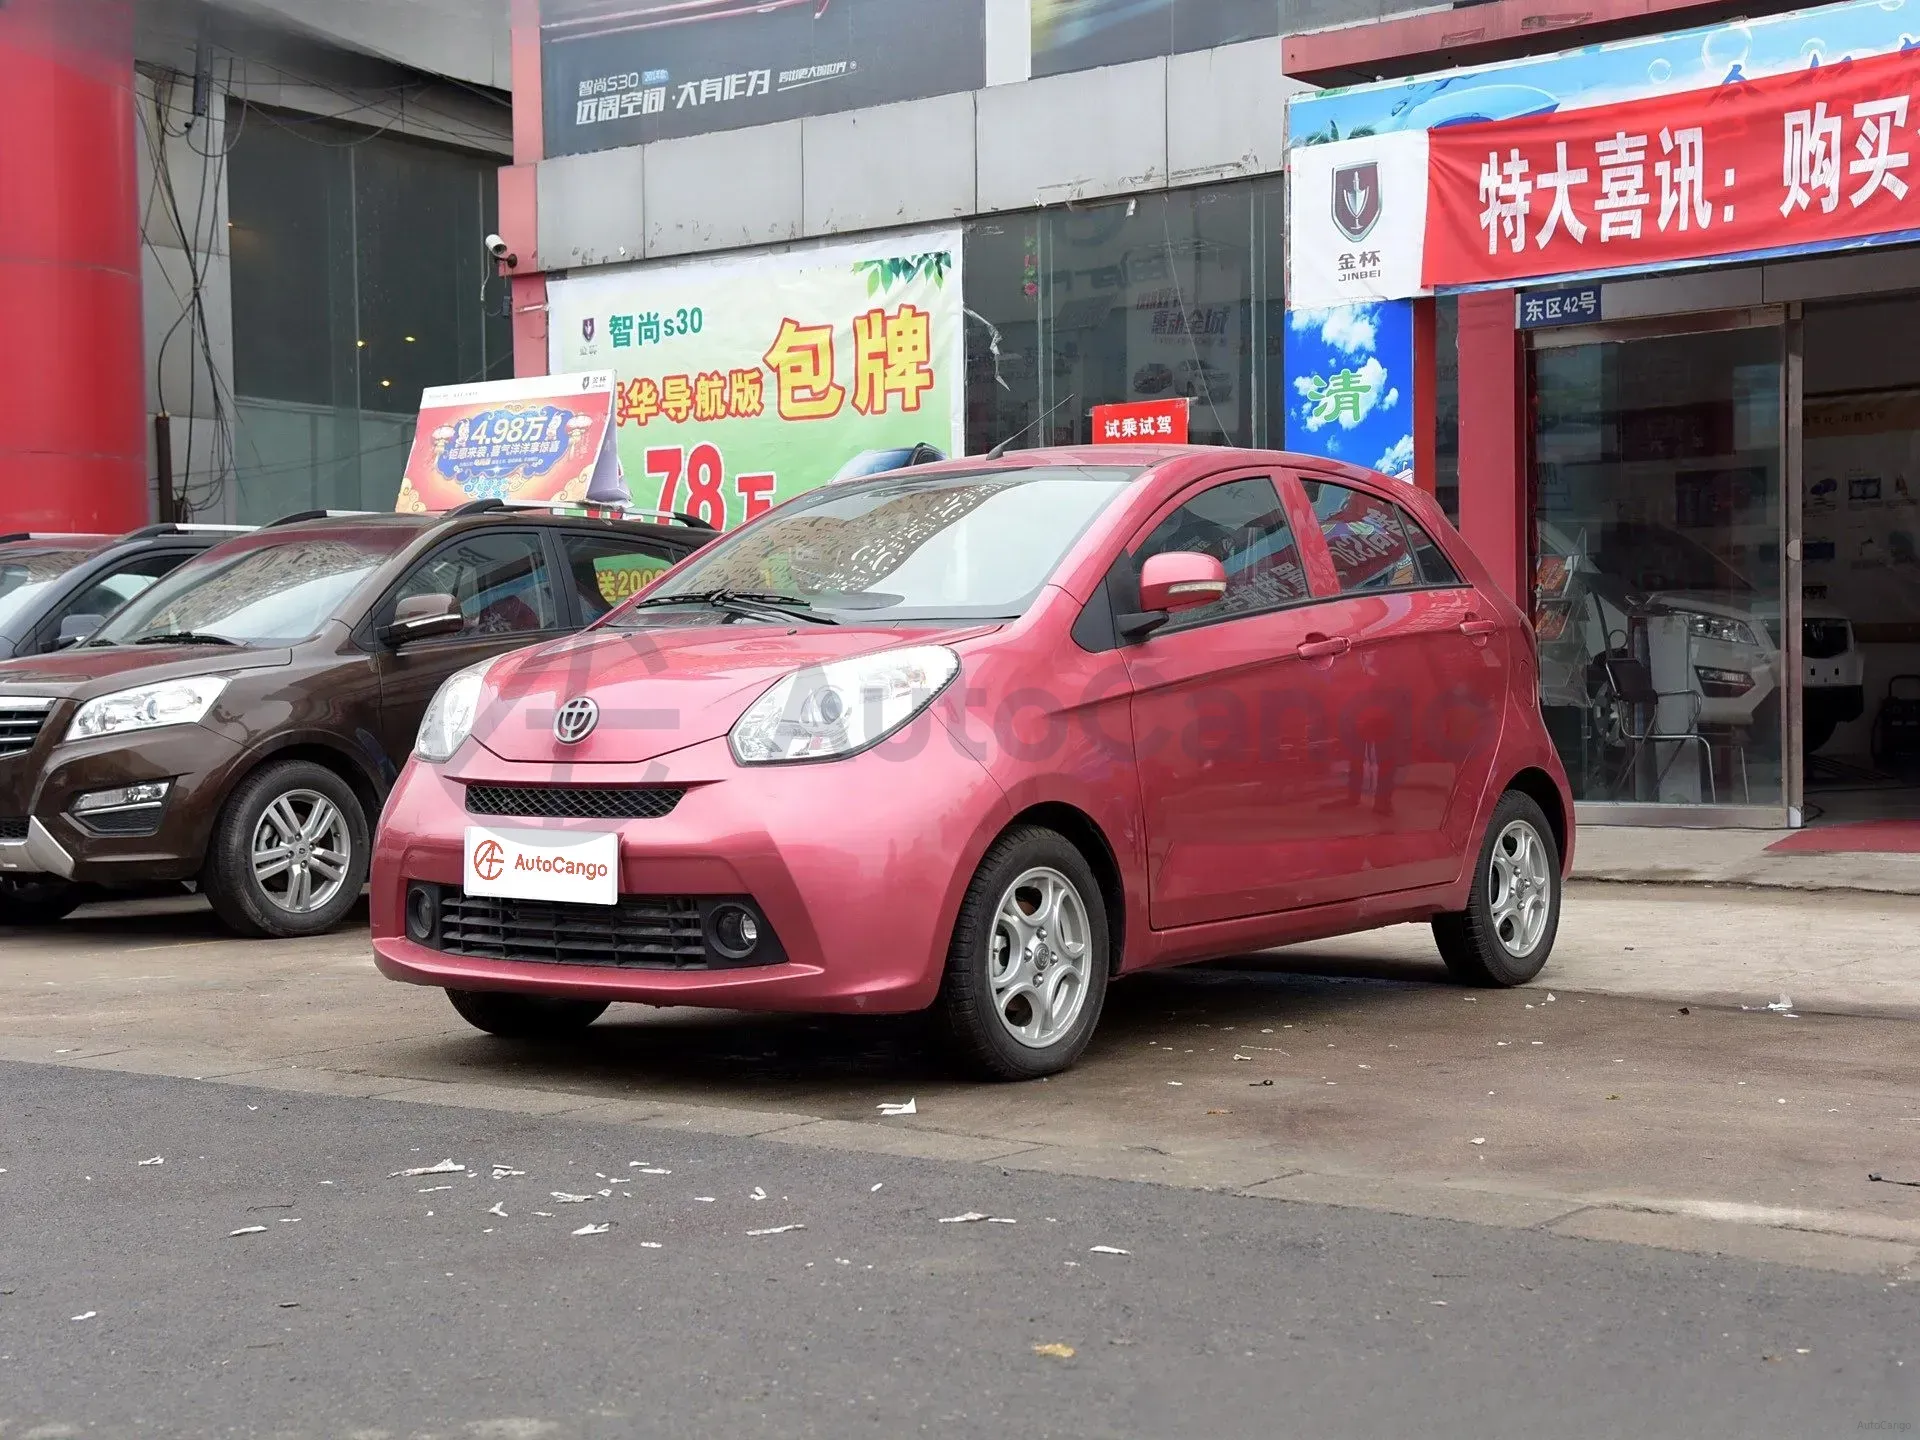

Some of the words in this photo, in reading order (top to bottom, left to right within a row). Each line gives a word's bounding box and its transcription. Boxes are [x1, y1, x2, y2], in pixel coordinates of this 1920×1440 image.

[578, 71, 640, 97] 智尚S30
[1338, 250, 1381, 270] 金杯
[1338, 270, 1381, 282] JINBEI
[1525, 291, 1597, 322] 东区42号
[609, 307, 703, 348] 智尚s30
[763, 304, 933, 421] 包牌
[1307, 368, 1372, 423] 清
[470, 416, 548, 444] 4.98万
[1104, 415, 1172, 438] 试乘试驾
